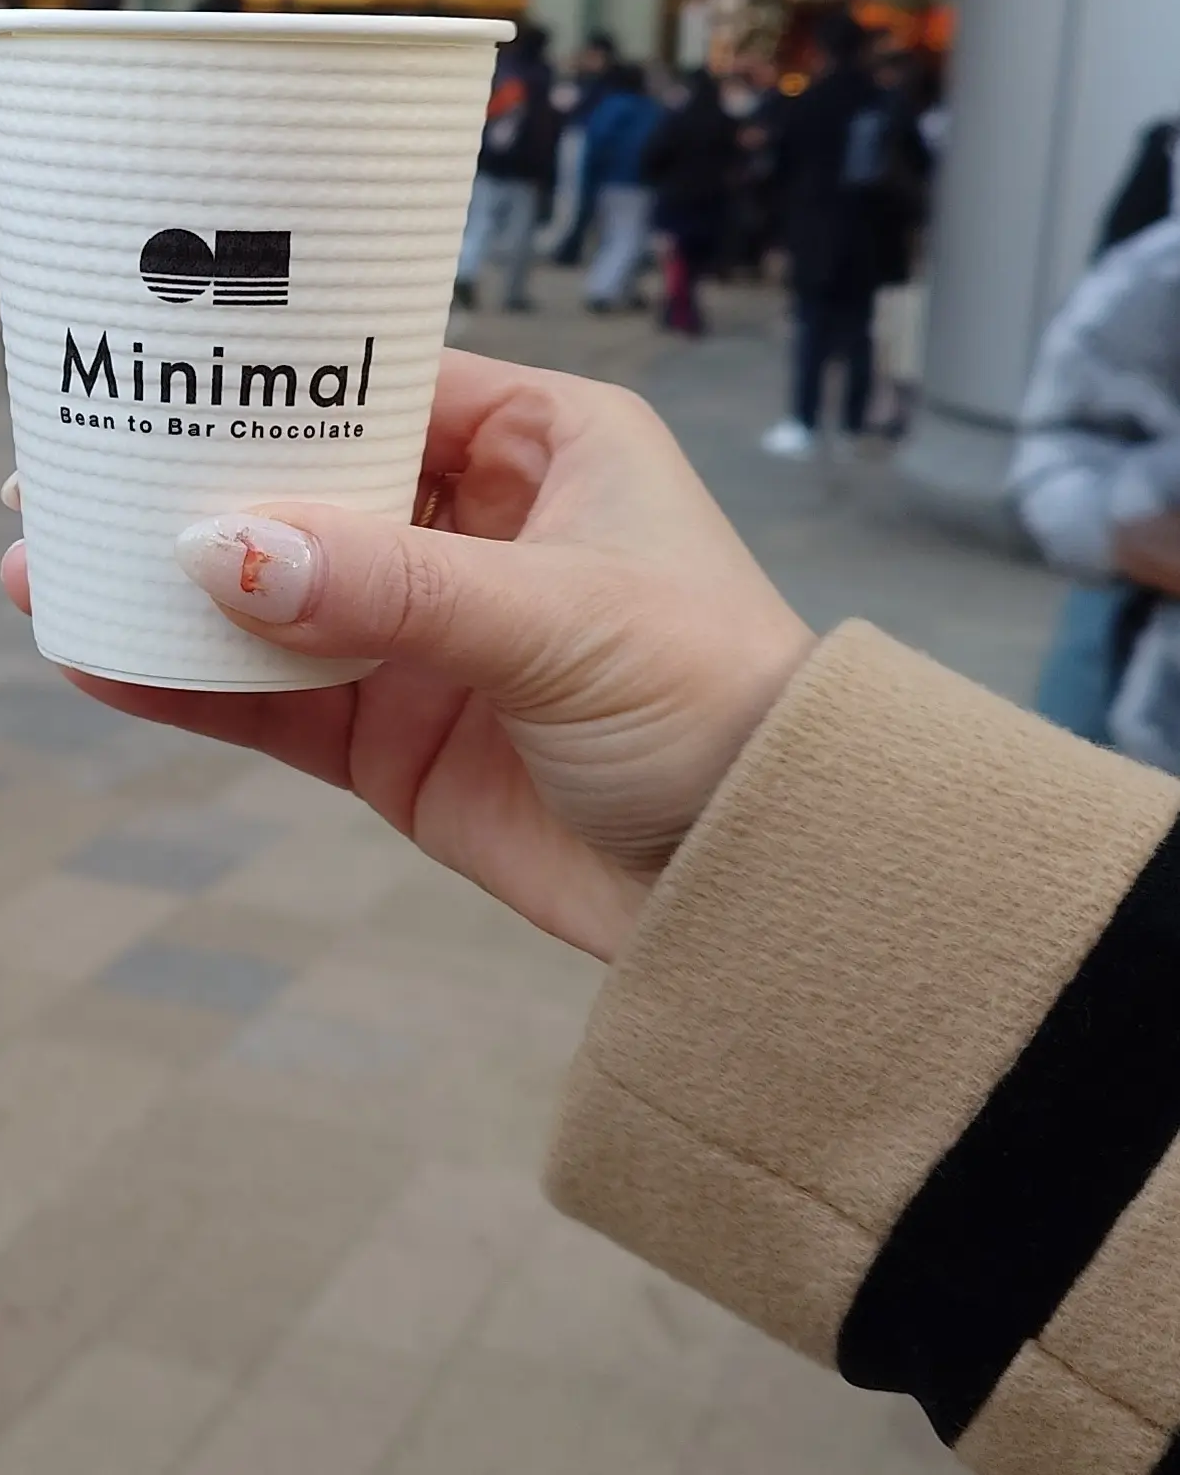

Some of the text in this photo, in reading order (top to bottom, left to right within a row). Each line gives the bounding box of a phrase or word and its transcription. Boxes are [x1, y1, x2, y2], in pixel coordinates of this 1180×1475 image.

[61, 327, 375, 408] Minimal
[60, 407, 365, 439] Bean to Bar Chocolate
